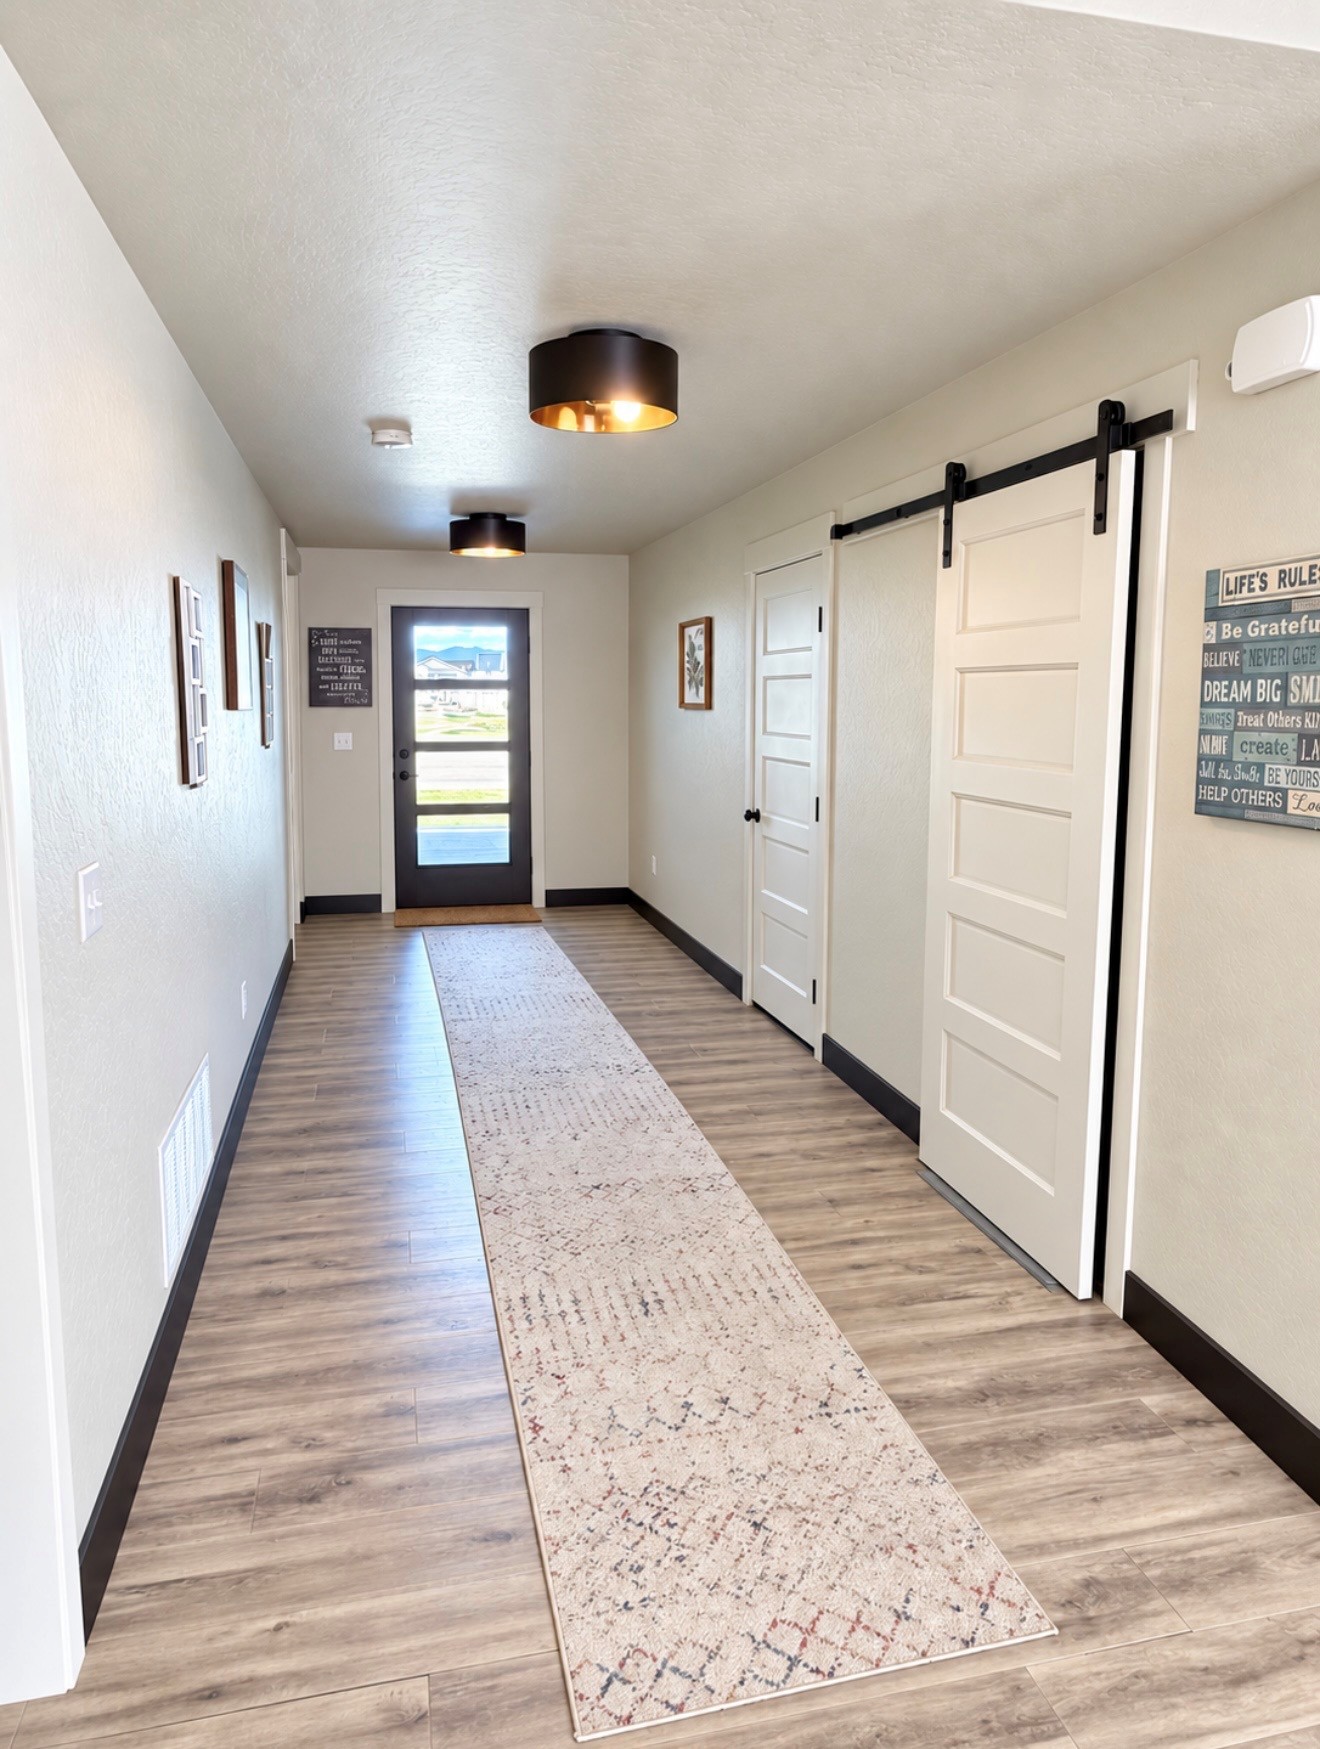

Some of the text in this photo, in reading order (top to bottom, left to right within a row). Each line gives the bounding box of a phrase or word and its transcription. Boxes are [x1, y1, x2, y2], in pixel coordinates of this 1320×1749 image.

[1225, 564, 1320, 596] LIFE'S RULE
[1221, 623, 1242, 639] Be
[1203, 651, 1240, 668] BELIEVE
[1203, 679, 1281, 702] DREAM BIG
[1237, 711, 1264, 727] Treat
[1267, 711, 1302, 728] Others
[1240, 738, 1289, 756] create
[1268, 767, 1282, 785] BE
[1198, 784, 1283, 808] HELP OTHERS
